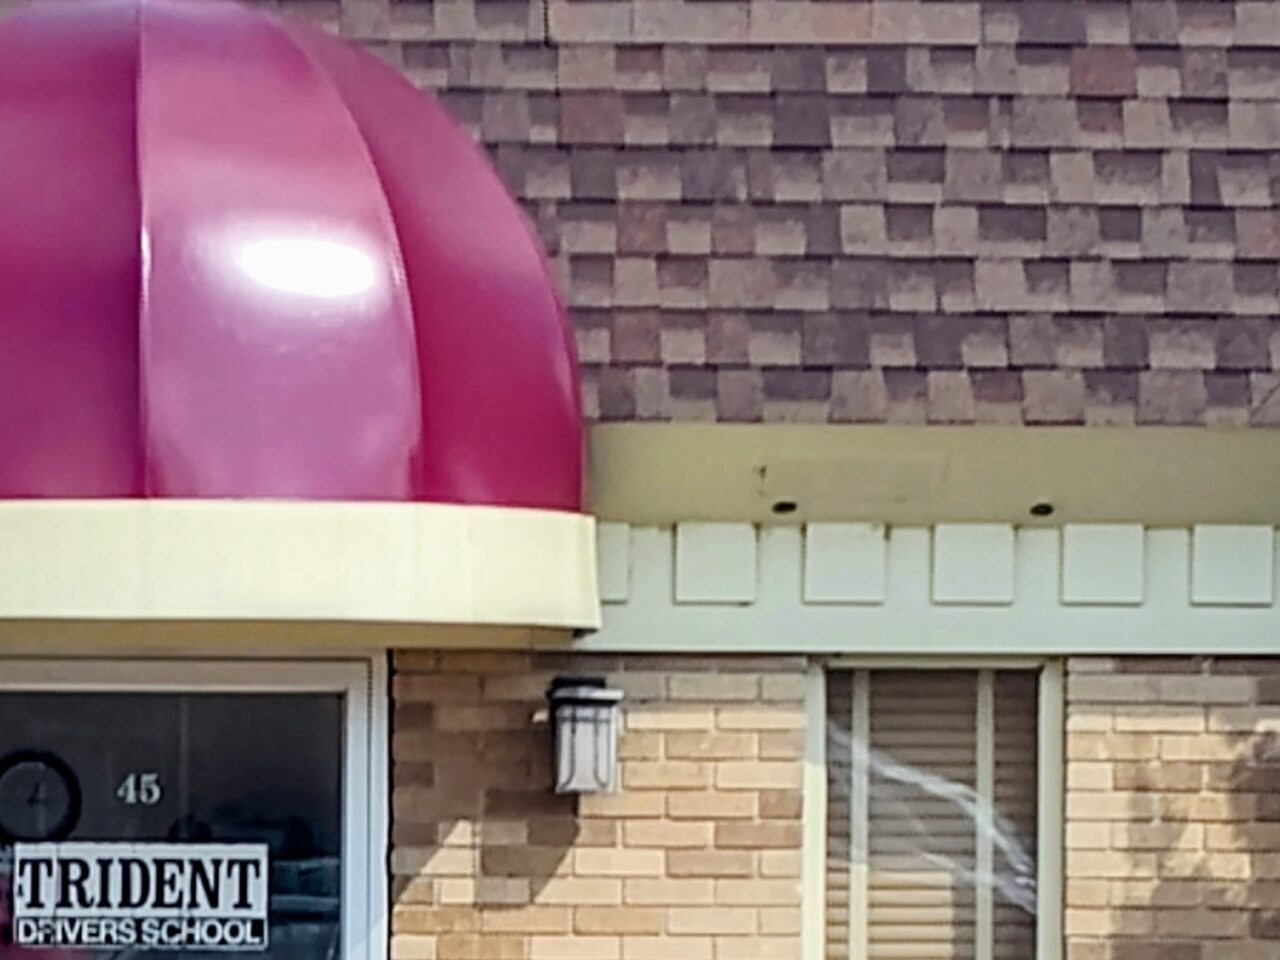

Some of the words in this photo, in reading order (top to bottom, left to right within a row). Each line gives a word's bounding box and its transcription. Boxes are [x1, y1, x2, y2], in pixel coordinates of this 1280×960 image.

[117, 773, 161, 804] 45
[19, 858, 261, 909] TRIDENT
[18, 919, 137, 944] DRIVERS
[141, 919, 261, 944] SCHOOL
